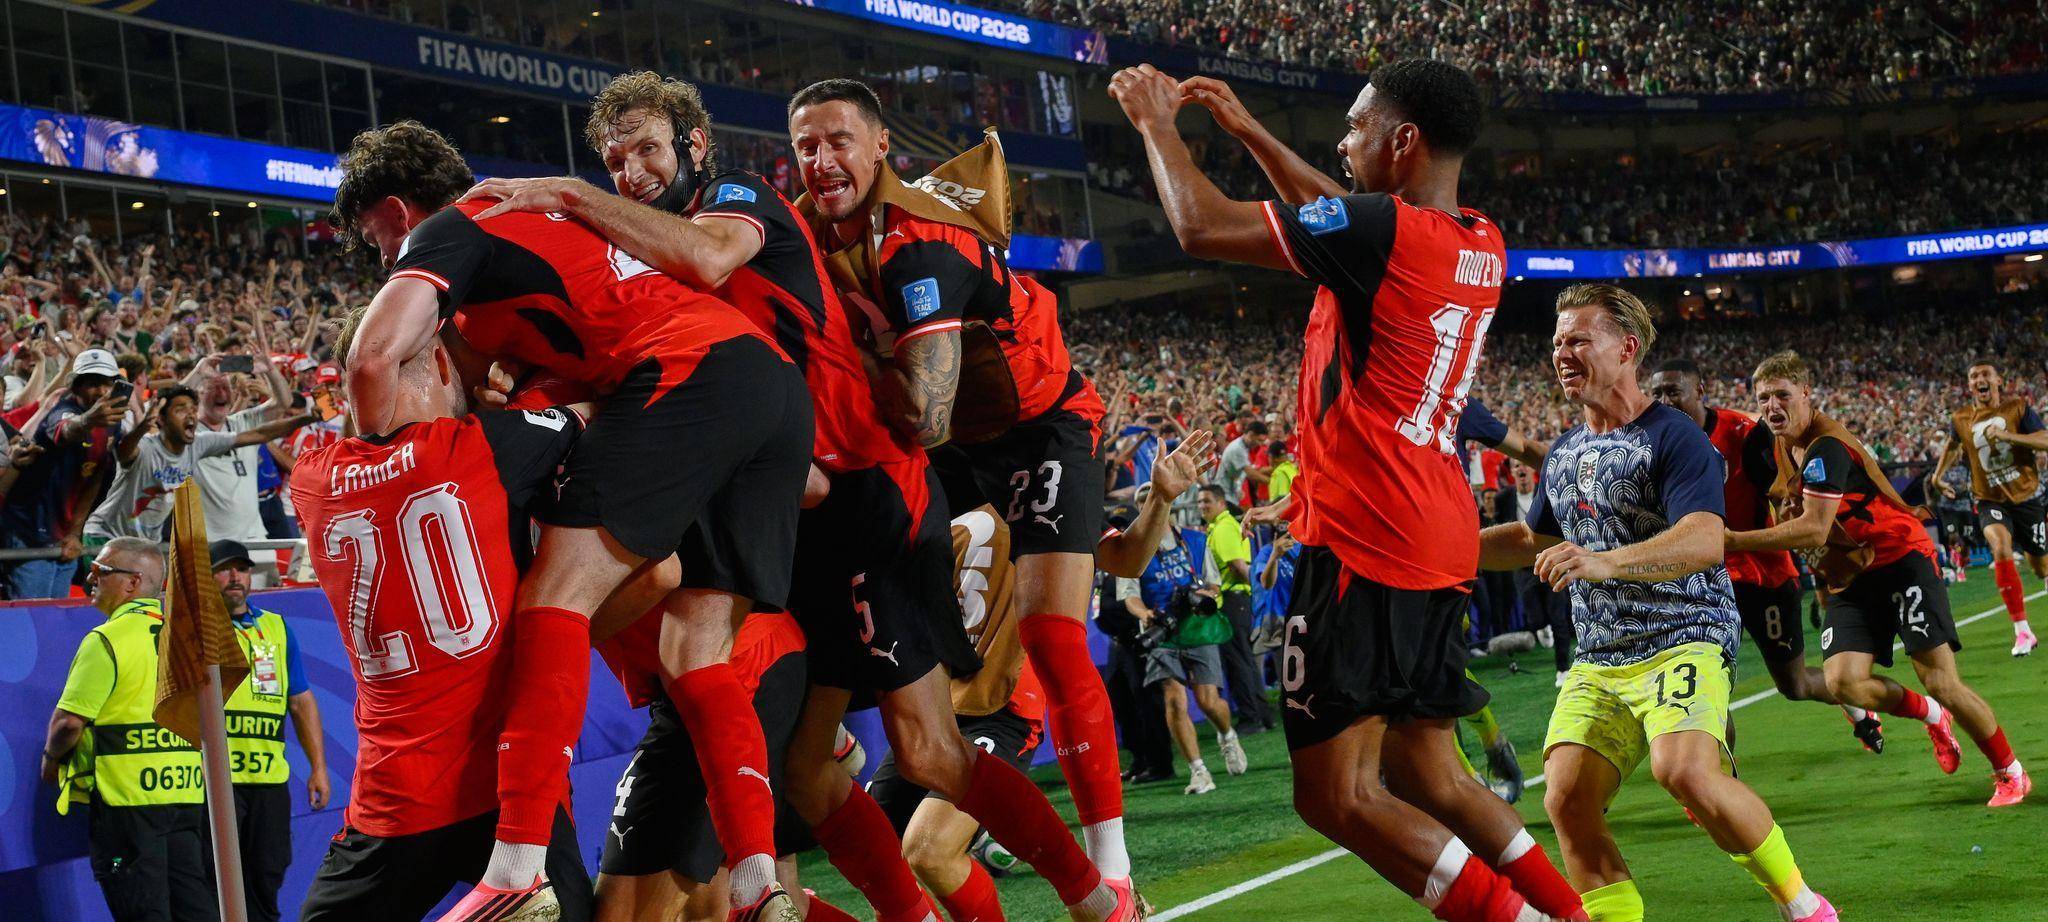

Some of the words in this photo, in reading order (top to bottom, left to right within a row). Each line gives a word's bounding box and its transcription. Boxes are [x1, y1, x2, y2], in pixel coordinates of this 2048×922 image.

[864, 0, 899, 18] FIFA
[899, 1, 951, 28] WORLD
[952, 11, 981, 34] CUP
[981, 17, 1031, 45] 2026
[417, 36, 474, 74] FIFA
[474, 47, 563, 88] WORLD
[567, 65, 613, 96] CUP
[1198, 57, 1274, 82] KANSAS
[1278, 70, 1318, 88] CITY
[1708, 252, 1765, 269] KANSAS
[1767, 249, 1801, 265] CITY
[1906, 239, 1940, 256] FIFA
[1940, 234, 1994, 253] WORLD
[1995, 231, 2029, 248] CUP
[1006, 460, 1063, 522] 23
[324, 481, 500, 682] 20
[851, 572, 876, 645] 5
[1765, 605, 1783, 641] 8
[1282, 614, 1308, 693] 6
[1654, 662, 1698, 708] 13
[126, 727, 192, 749] SECU
[225, 715, 281, 737] URITY
[140, 765, 203, 792] 06370
[231, 751, 275, 774] 357
[613, 749, 645, 817] 4
